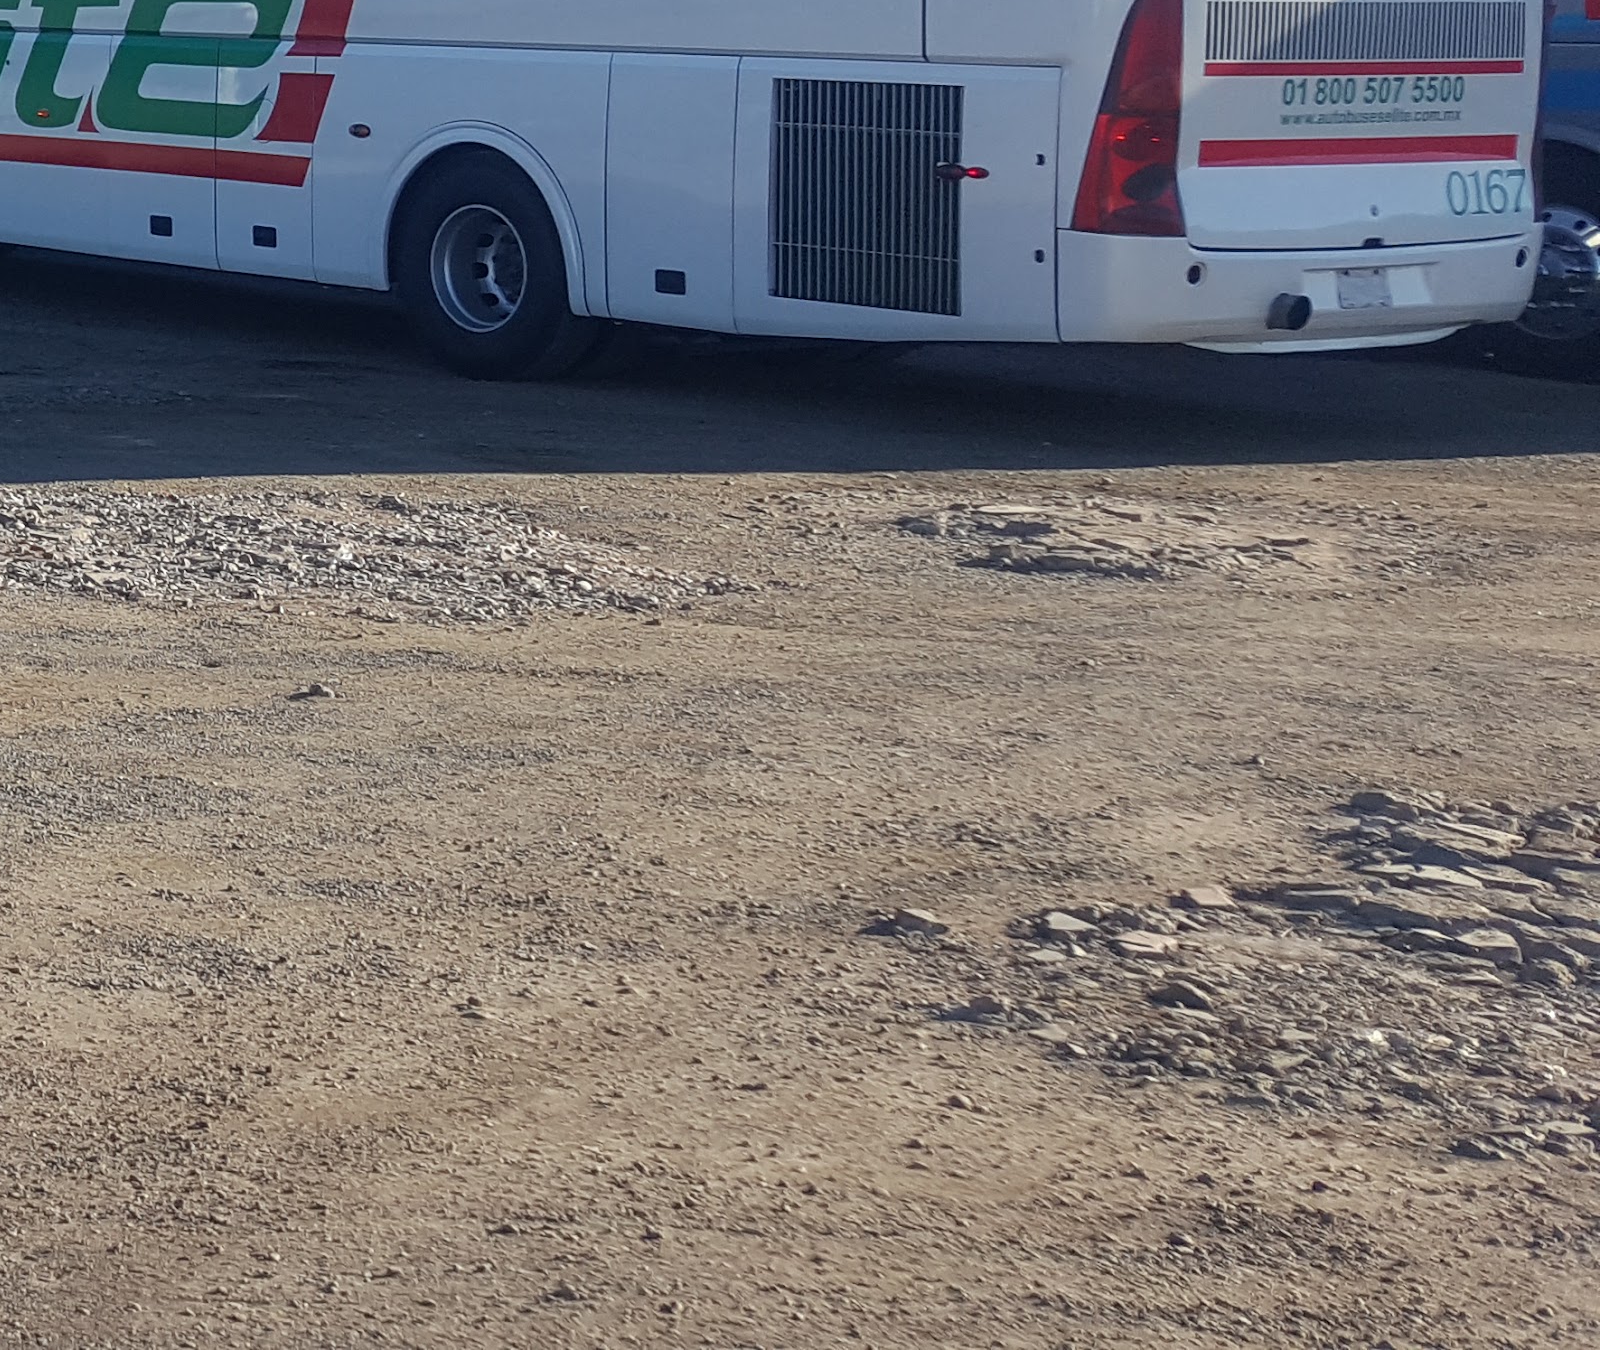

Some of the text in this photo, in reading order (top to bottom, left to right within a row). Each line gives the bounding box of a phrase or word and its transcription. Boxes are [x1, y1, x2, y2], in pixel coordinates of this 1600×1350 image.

[1282, 75, 1466, 107] 01 800 507 5500
[1445, 168, 1527, 217] 0167
